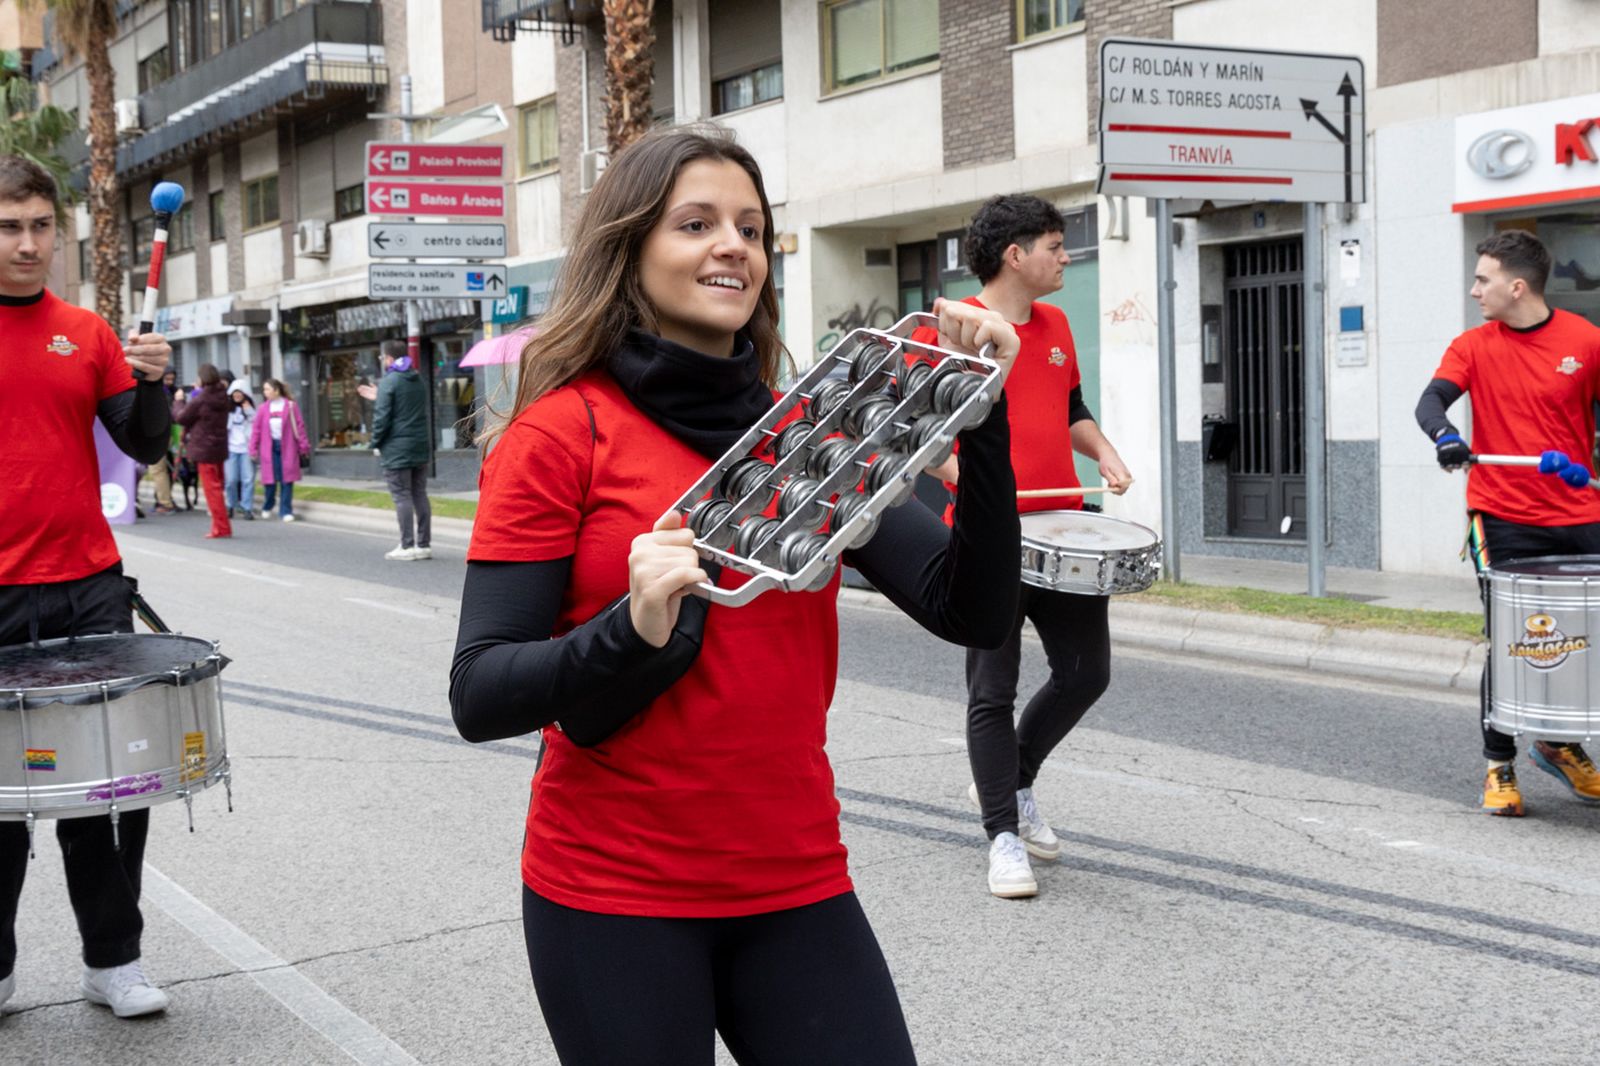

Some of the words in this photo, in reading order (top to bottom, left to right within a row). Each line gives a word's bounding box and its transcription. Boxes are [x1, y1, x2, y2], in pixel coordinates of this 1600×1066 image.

[1109, 56, 1125, 74] C/
[1133, 57, 1193, 78] ROLDÁN
[1200, 63, 1209, 78] Y
[1216, 62, 1264, 82] MARÍN
[1109, 87, 1126, 104] C/
[1167, 89, 1222, 108] TORRES
[1228, 94, 1282, 111] ACOSTA
[1168, 144, 1234, 165] TRANVÍA
[419, 156, 454, 167] Palacio
[456, 156, 501, 168] Provincial
[420, 193, 457, 206] Baños
[462, 192, 502, 207] Árabes
[423, 235, 462, 246] centro
[466, 236, 503, 247] ciudad
[372, 270, 415, 278] residencia
[373, 283, 402, 292] Ciudad
[408, 284, 418, 292] de
